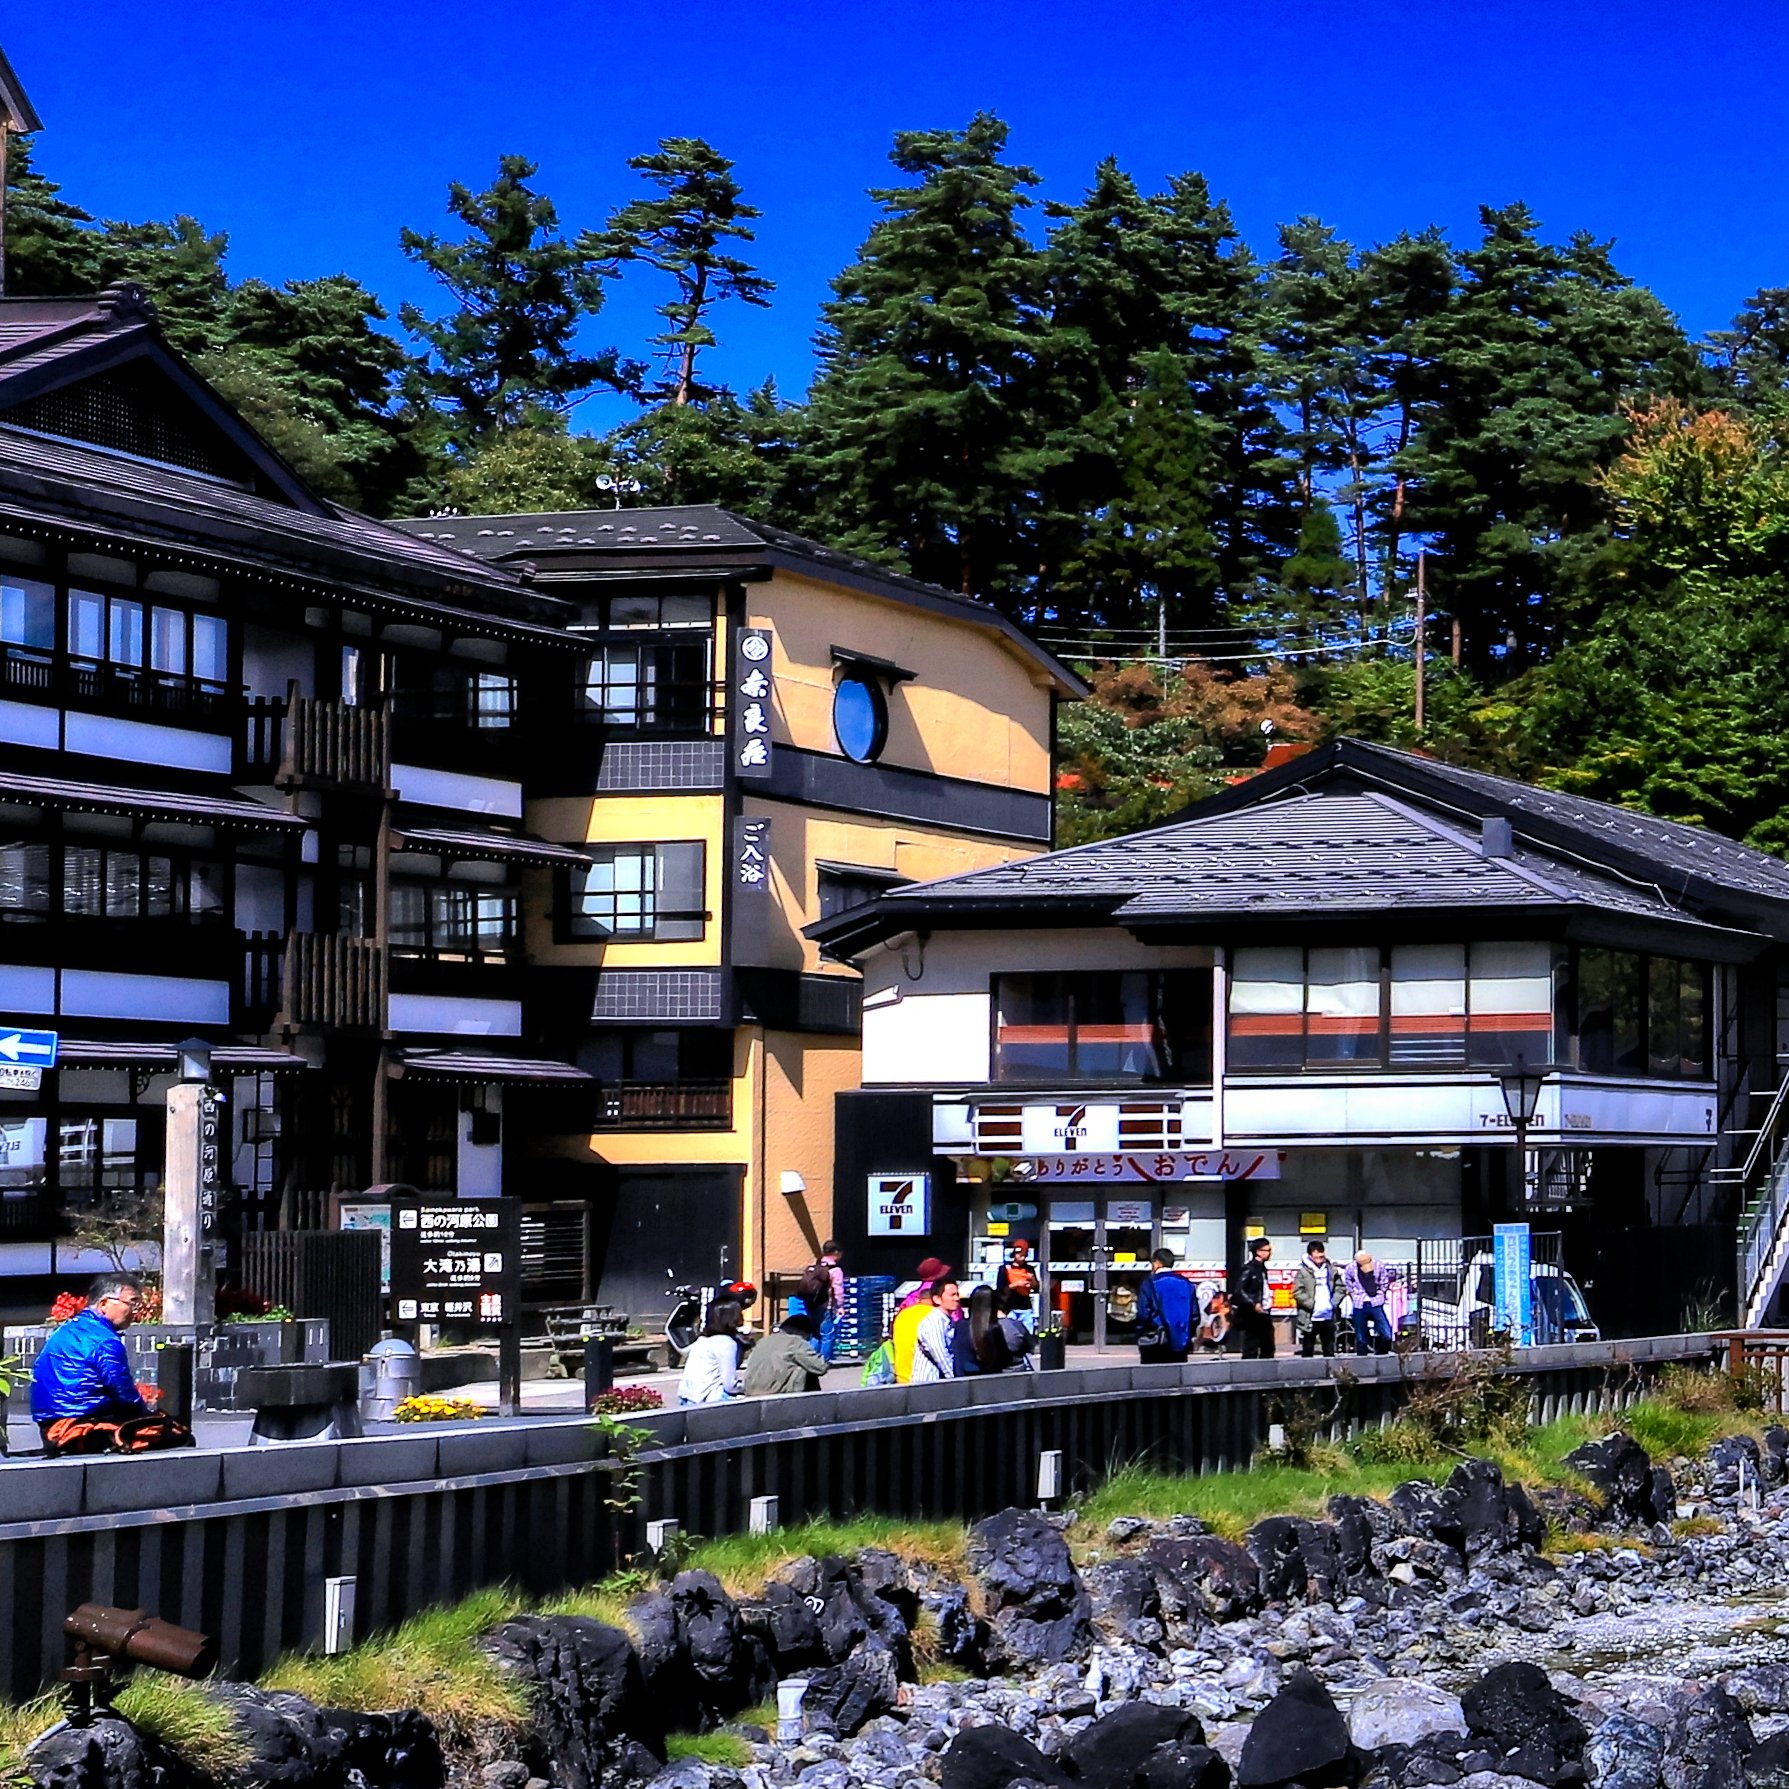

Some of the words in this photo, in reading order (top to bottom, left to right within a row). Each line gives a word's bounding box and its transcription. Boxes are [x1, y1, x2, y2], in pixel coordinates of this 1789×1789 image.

[739, 822, 765, 884] ご入浴
[1153, 1153, 1240, 1178] おでん
[420, 1213, 499, 1228] 西の河原公園
[880, 1181, 913, 1229] 7
